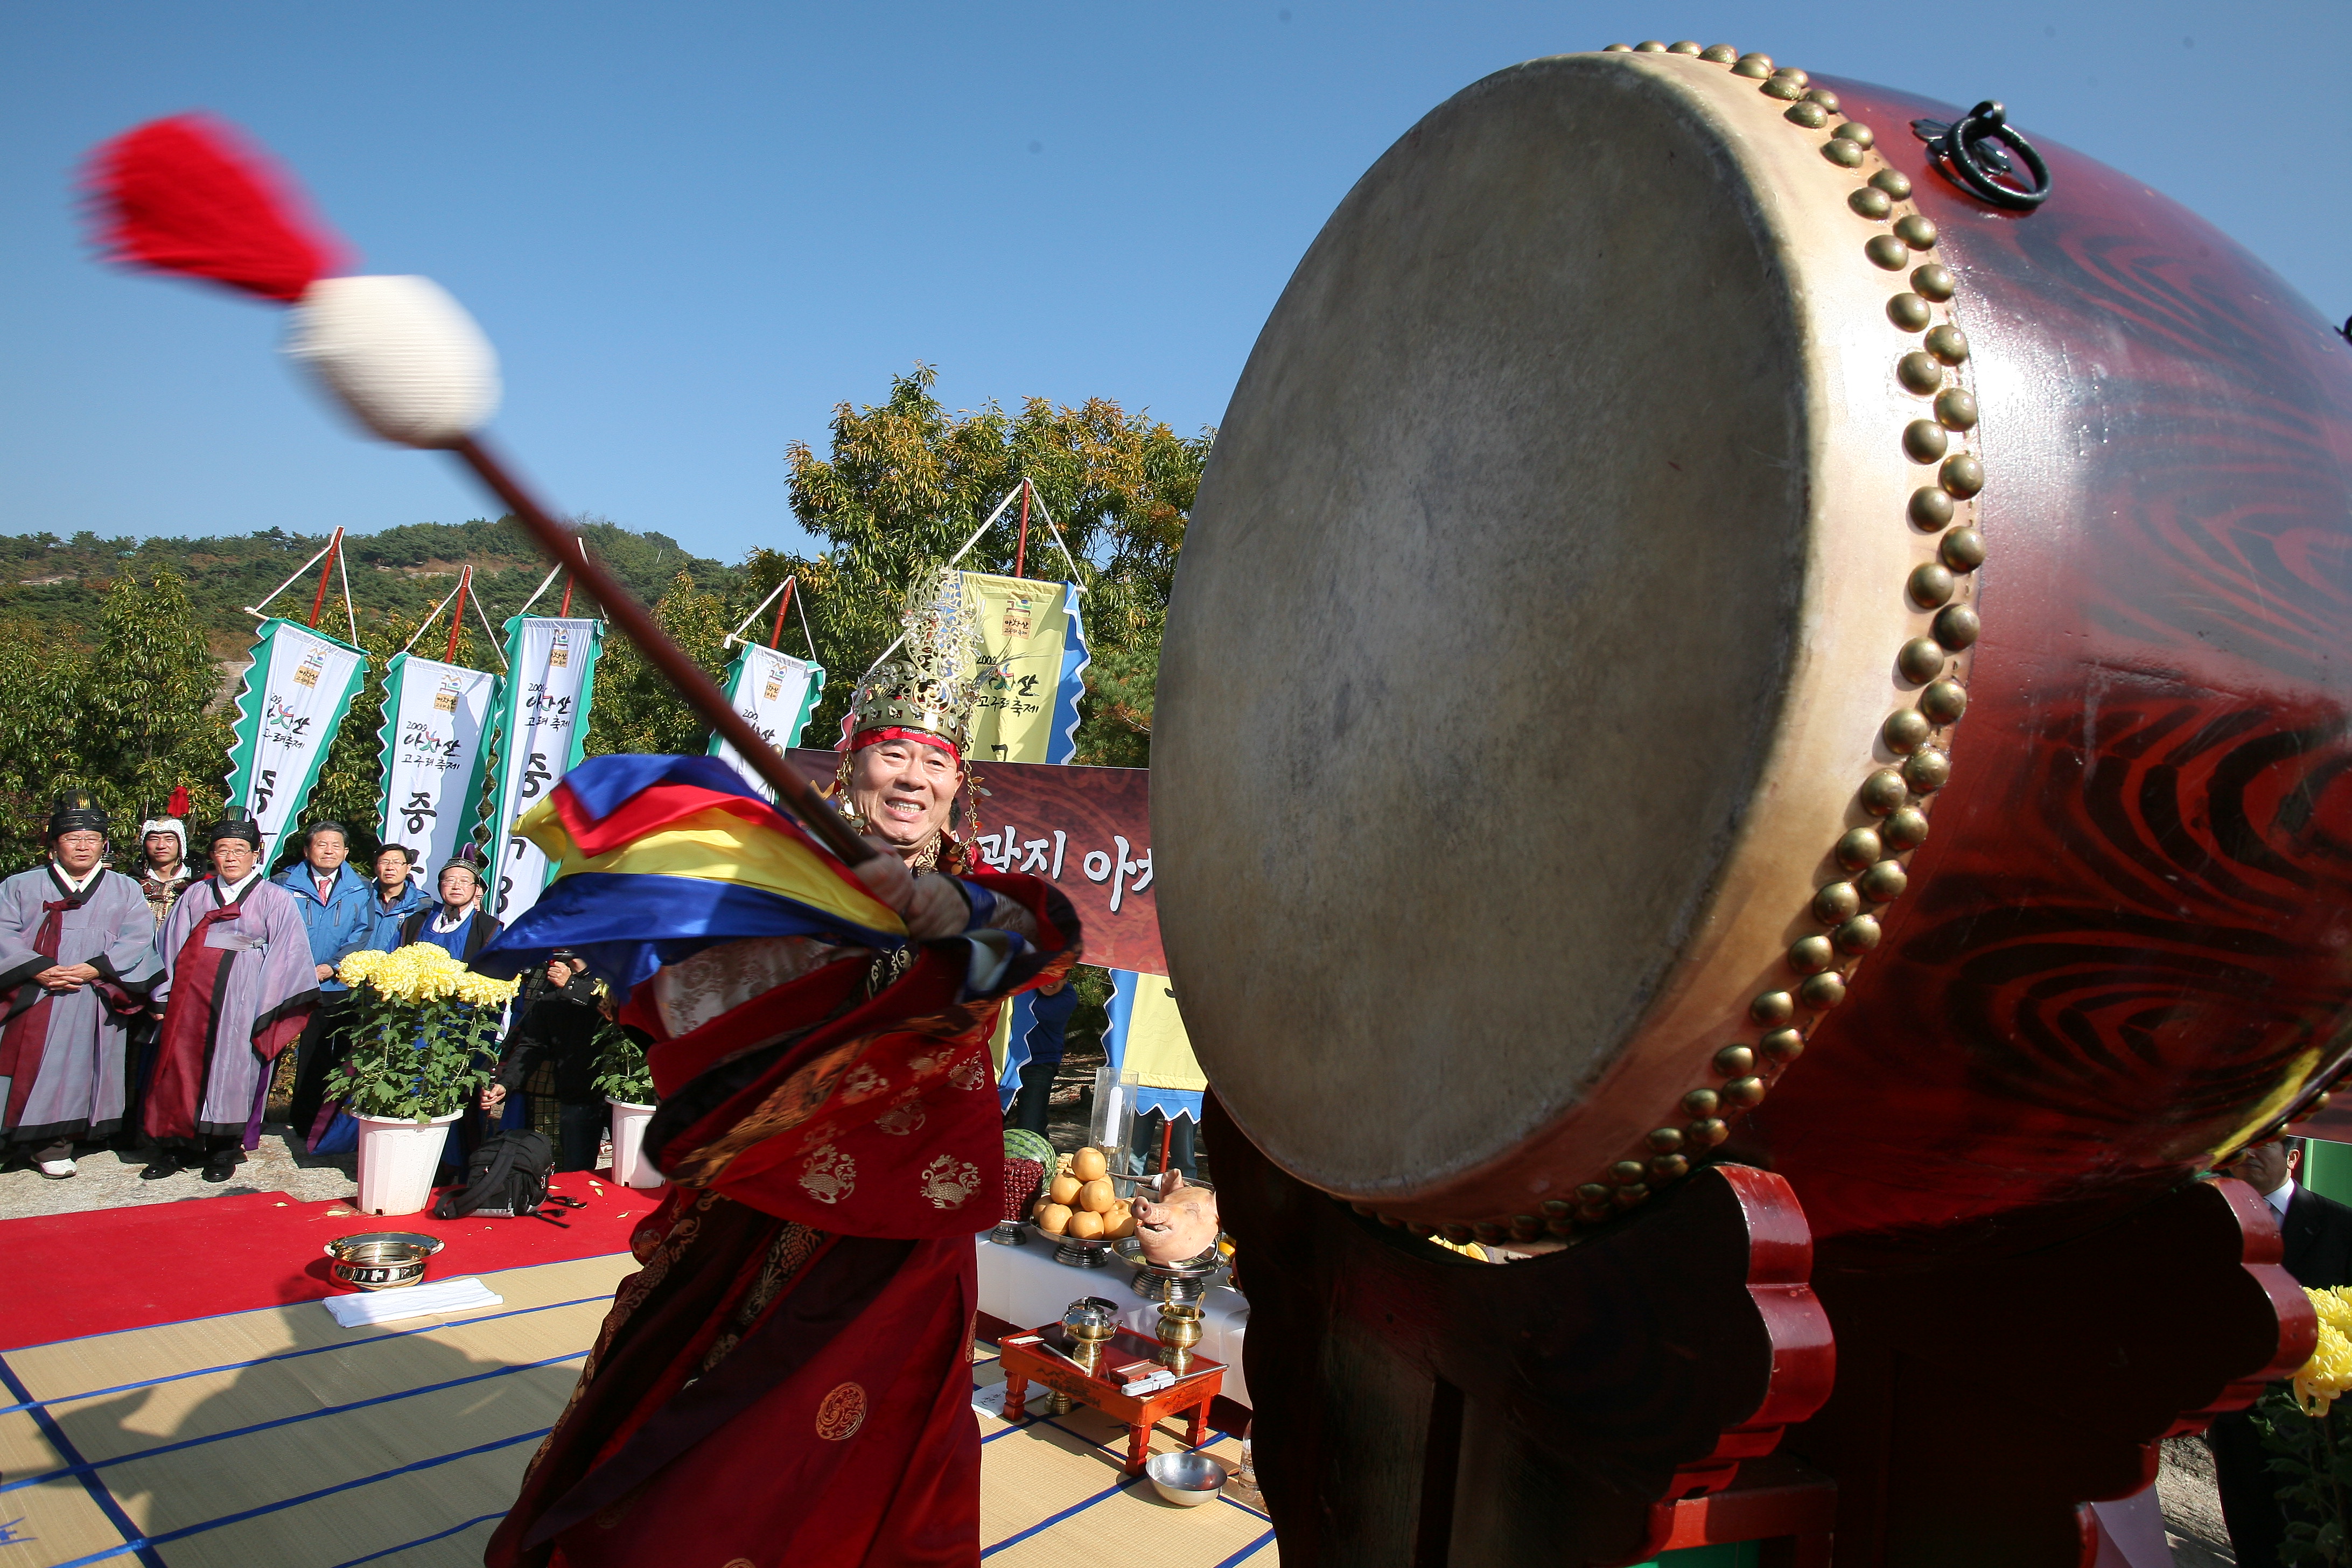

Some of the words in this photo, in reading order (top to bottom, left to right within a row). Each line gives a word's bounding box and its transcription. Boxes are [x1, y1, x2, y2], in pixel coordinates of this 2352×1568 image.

[1005, 618, 1028, 629] 아차산
[551, 651, 567, 660] 차산
[437, 696, 457, 705] 아차산
[742, 709, 758, 721] 200
[407, 721, 428, 732] 2009
[404, 730, 461, 757] 아차산
